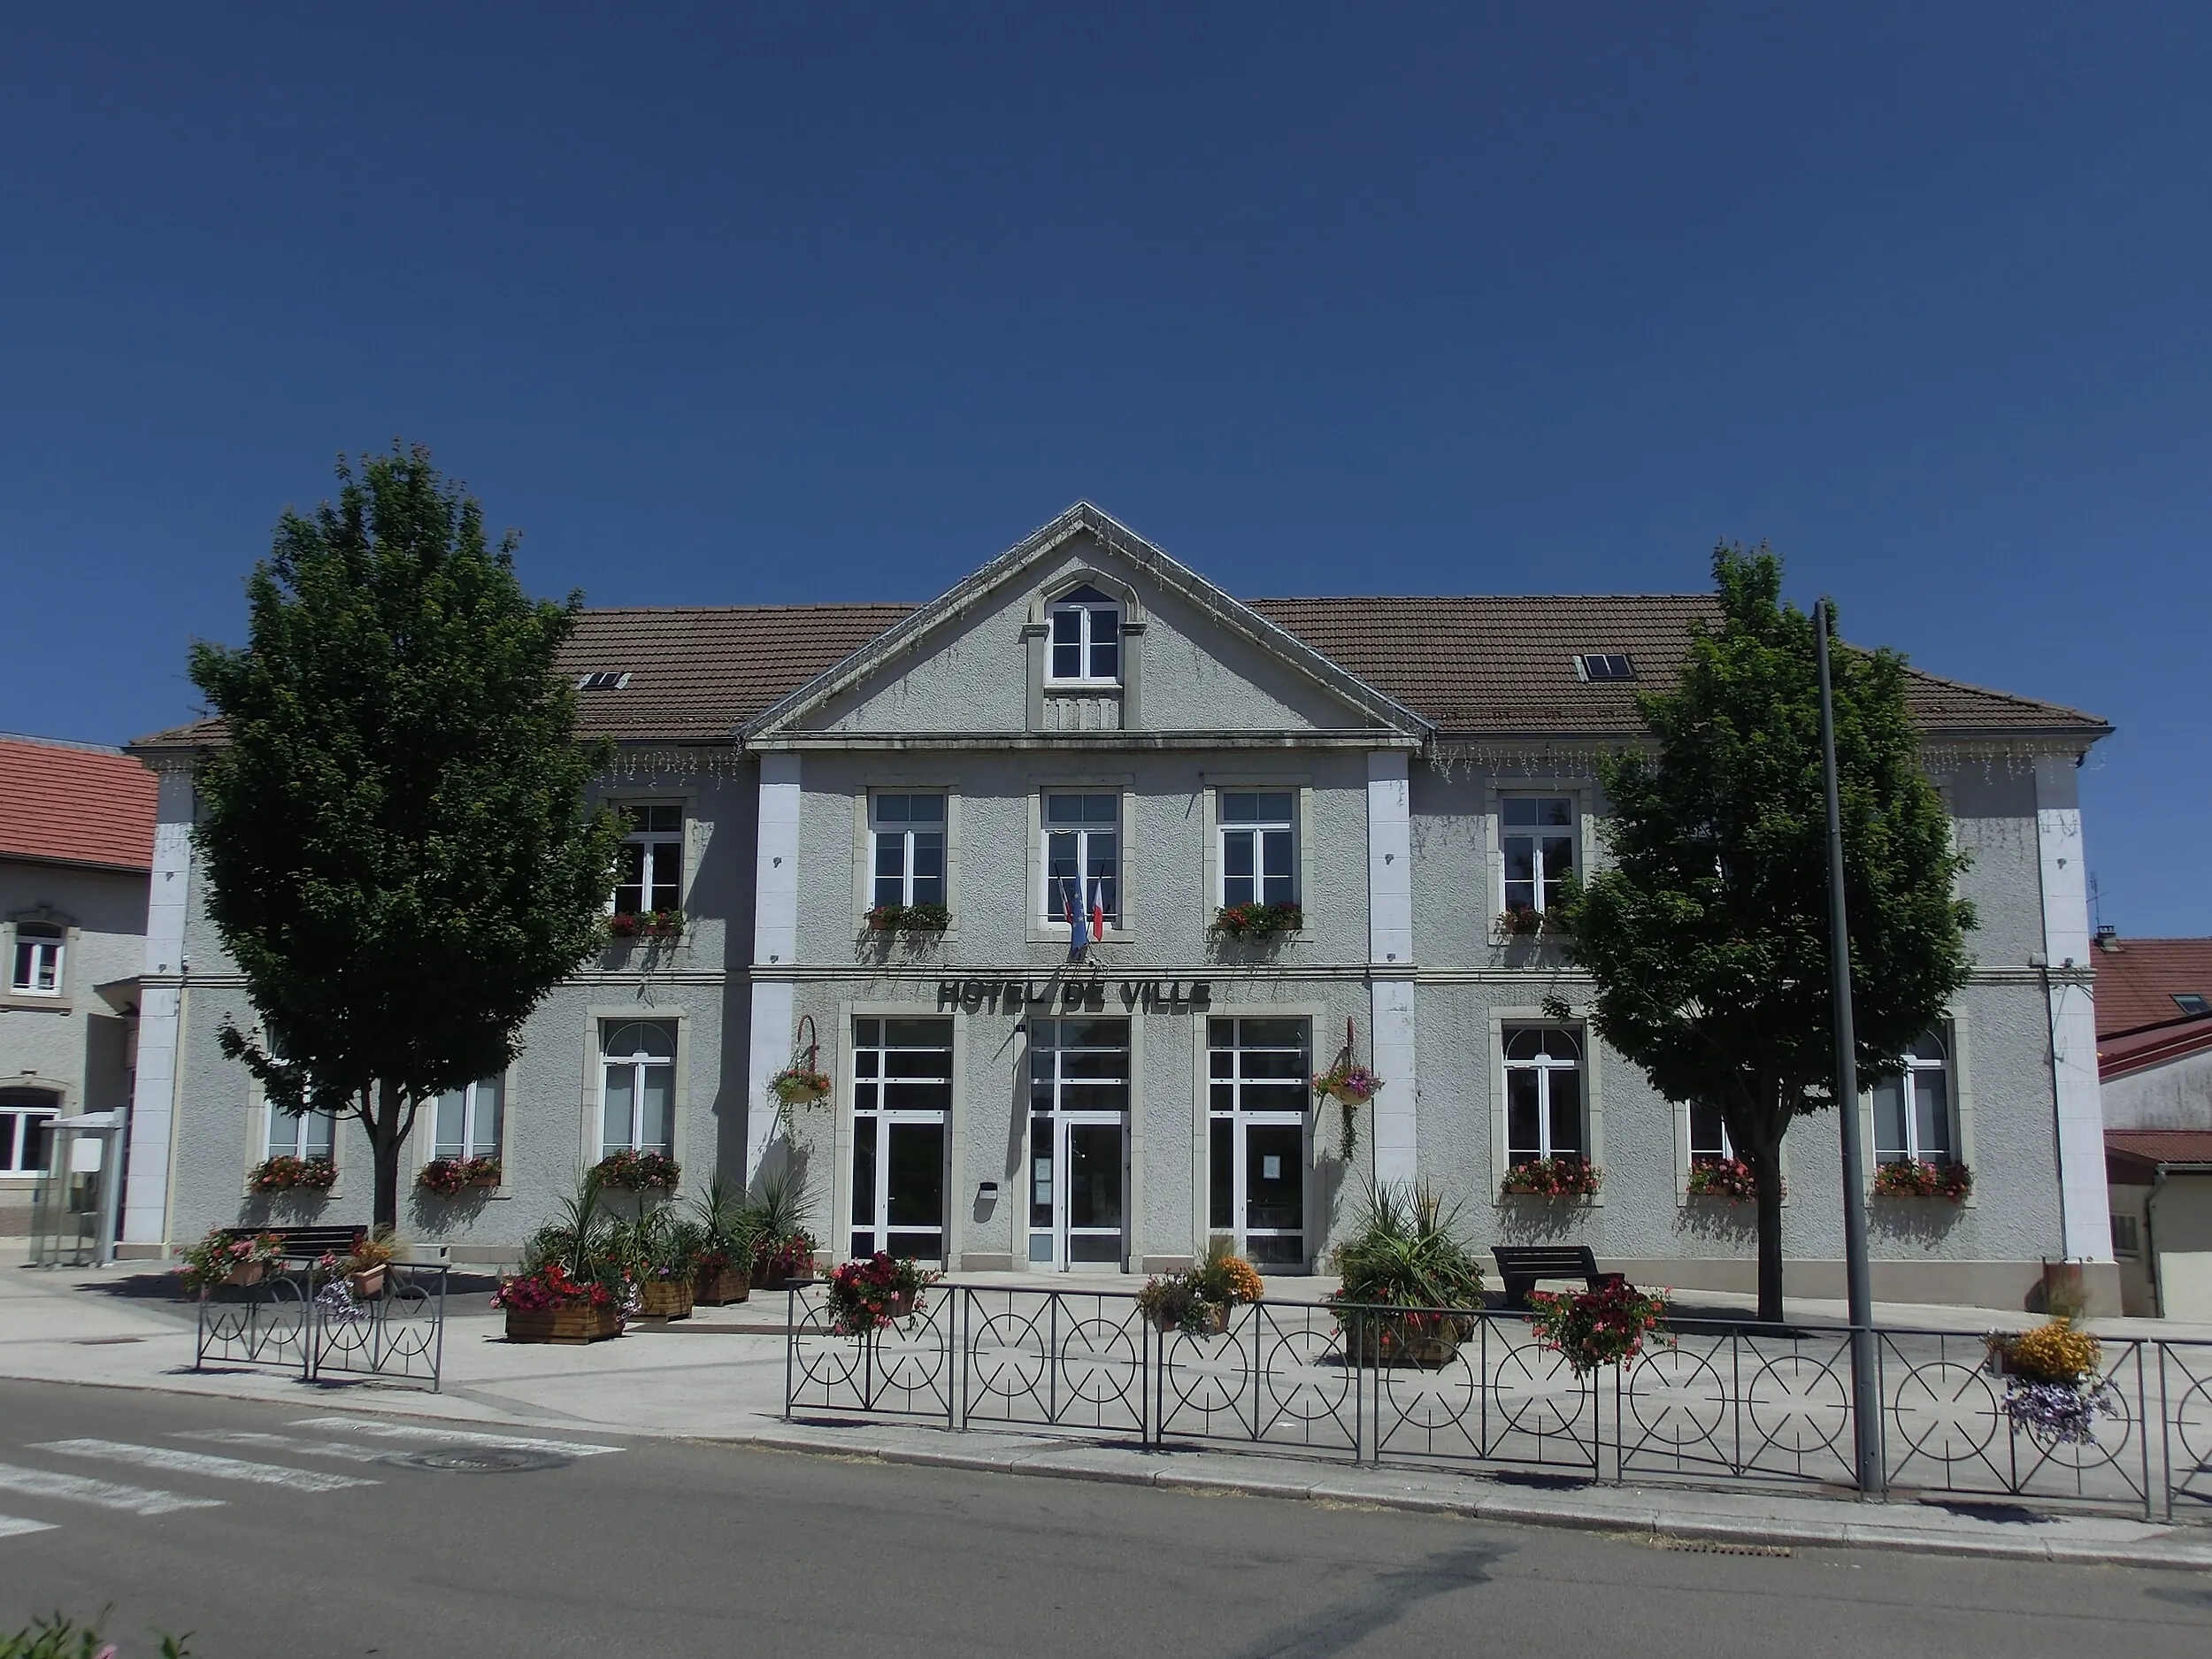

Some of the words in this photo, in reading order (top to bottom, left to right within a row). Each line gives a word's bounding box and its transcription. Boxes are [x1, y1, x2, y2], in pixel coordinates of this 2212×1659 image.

[941, 979, 1045, 1007] HOTEL
[1064, 979, 1106, 1007] DE
[1122, 979, 1211, 1007] VILLE
